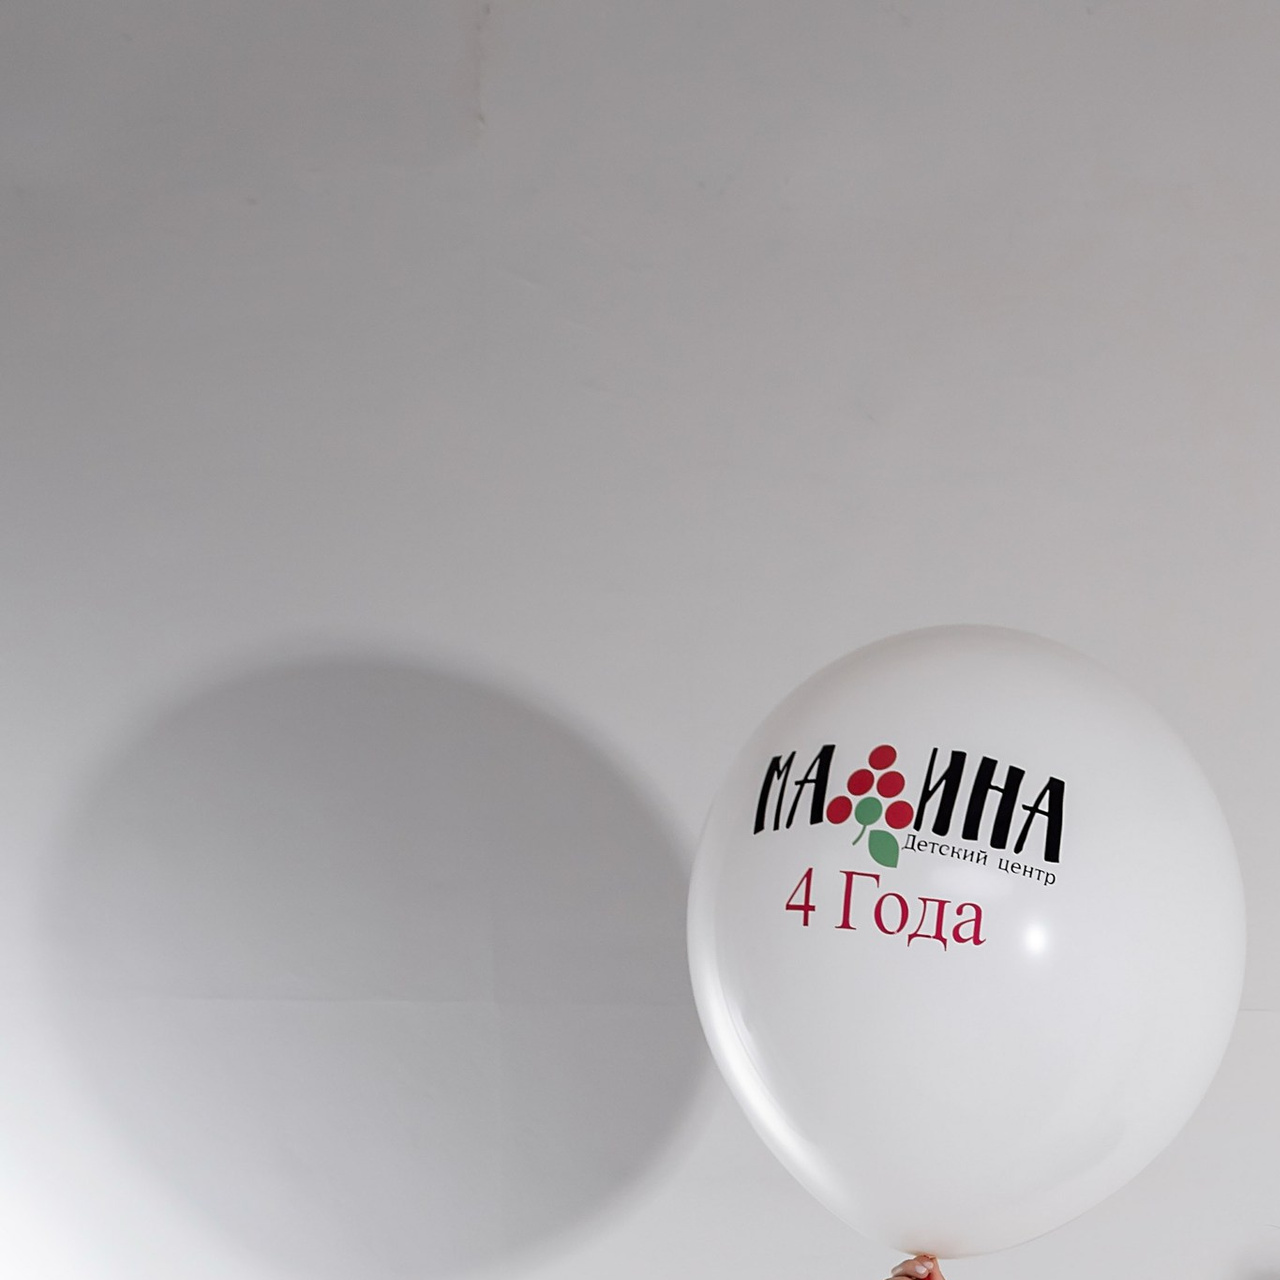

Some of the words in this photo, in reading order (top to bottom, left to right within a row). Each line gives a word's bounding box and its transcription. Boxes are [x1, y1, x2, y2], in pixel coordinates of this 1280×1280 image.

[901, 833, 988, 867] Детский
[997, 855, 1057, 886] центр
[785, 868, 816, 927] 4
[834, 870, 987, 951] Года
